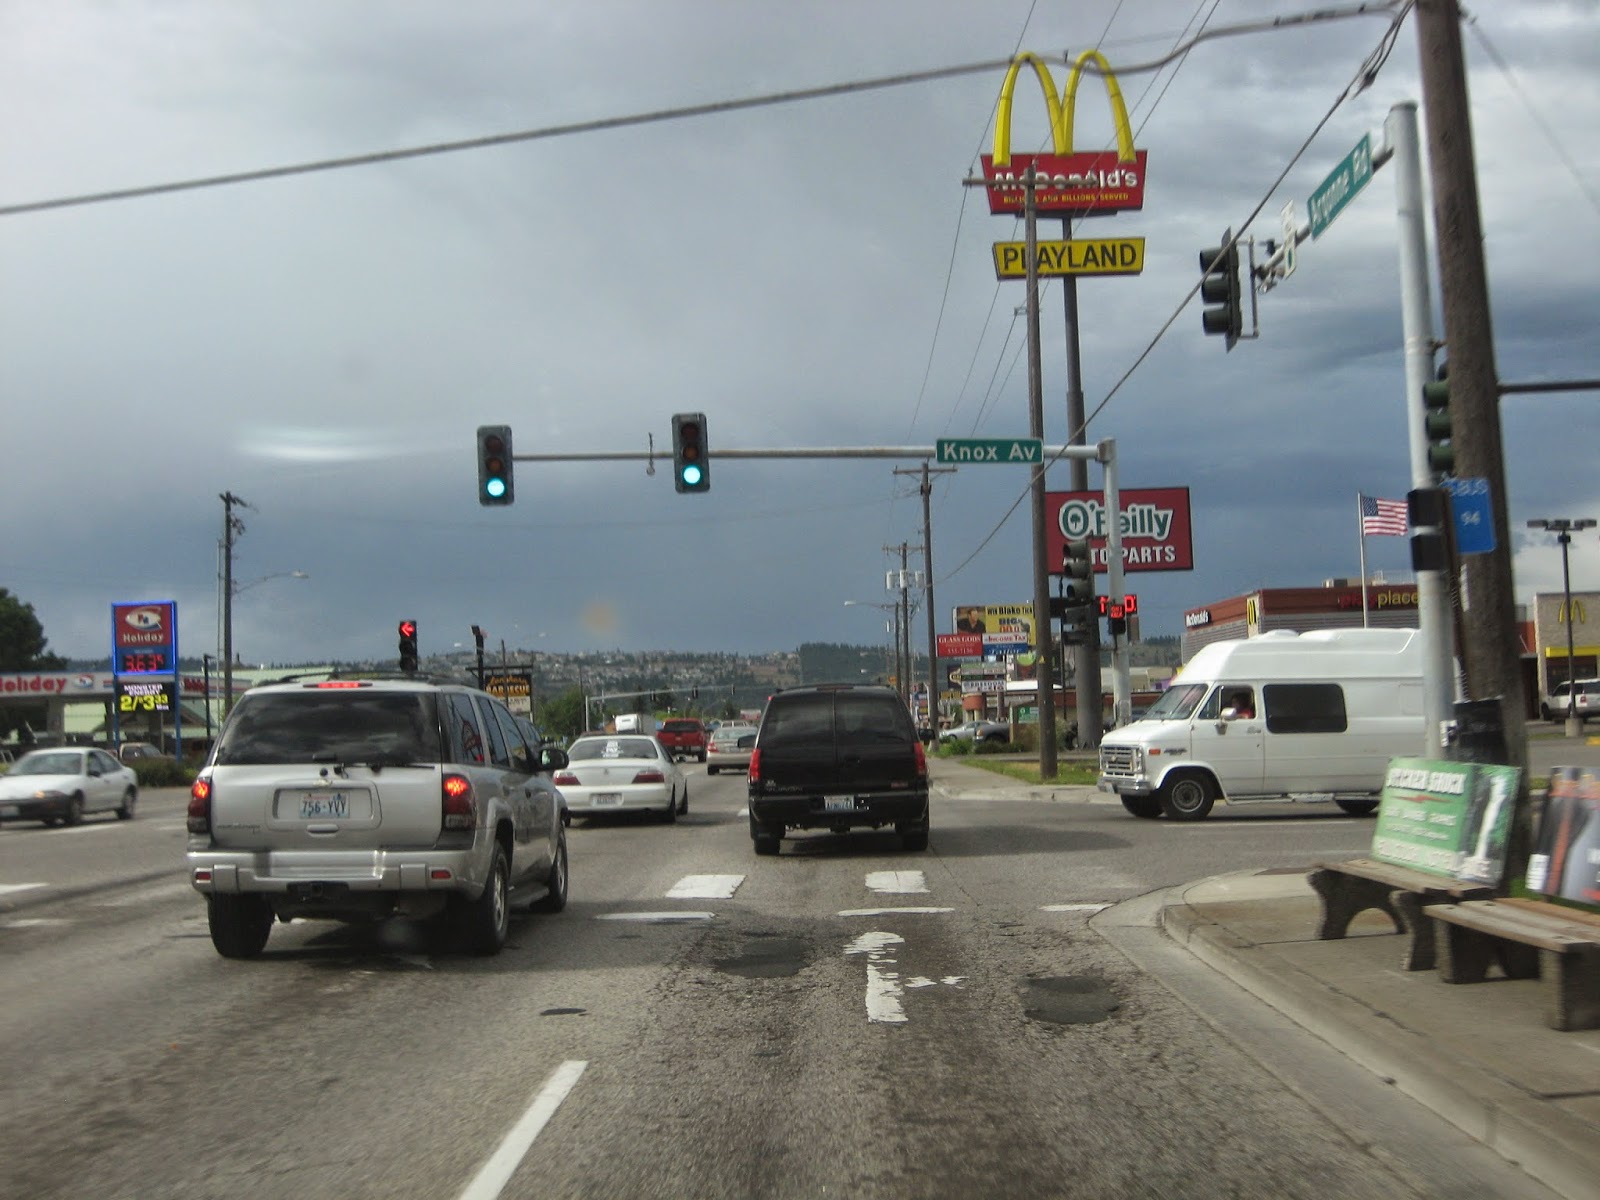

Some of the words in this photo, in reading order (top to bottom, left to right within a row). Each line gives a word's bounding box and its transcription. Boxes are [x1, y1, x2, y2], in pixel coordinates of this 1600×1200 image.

[1061, 193, 1096, 203] BILLIONS
[1099, 192, 1129, 202] SERVED
[943, 442, 998, 461] Knox
[1009, 442, 1036, 461] Av
[1121, 545, 1176, 564] PARTS
[122, 632, 164, 644] Holiday
[0, 675, 67, 693] oliday
[302, 798, 347, 817] 756-YVY
